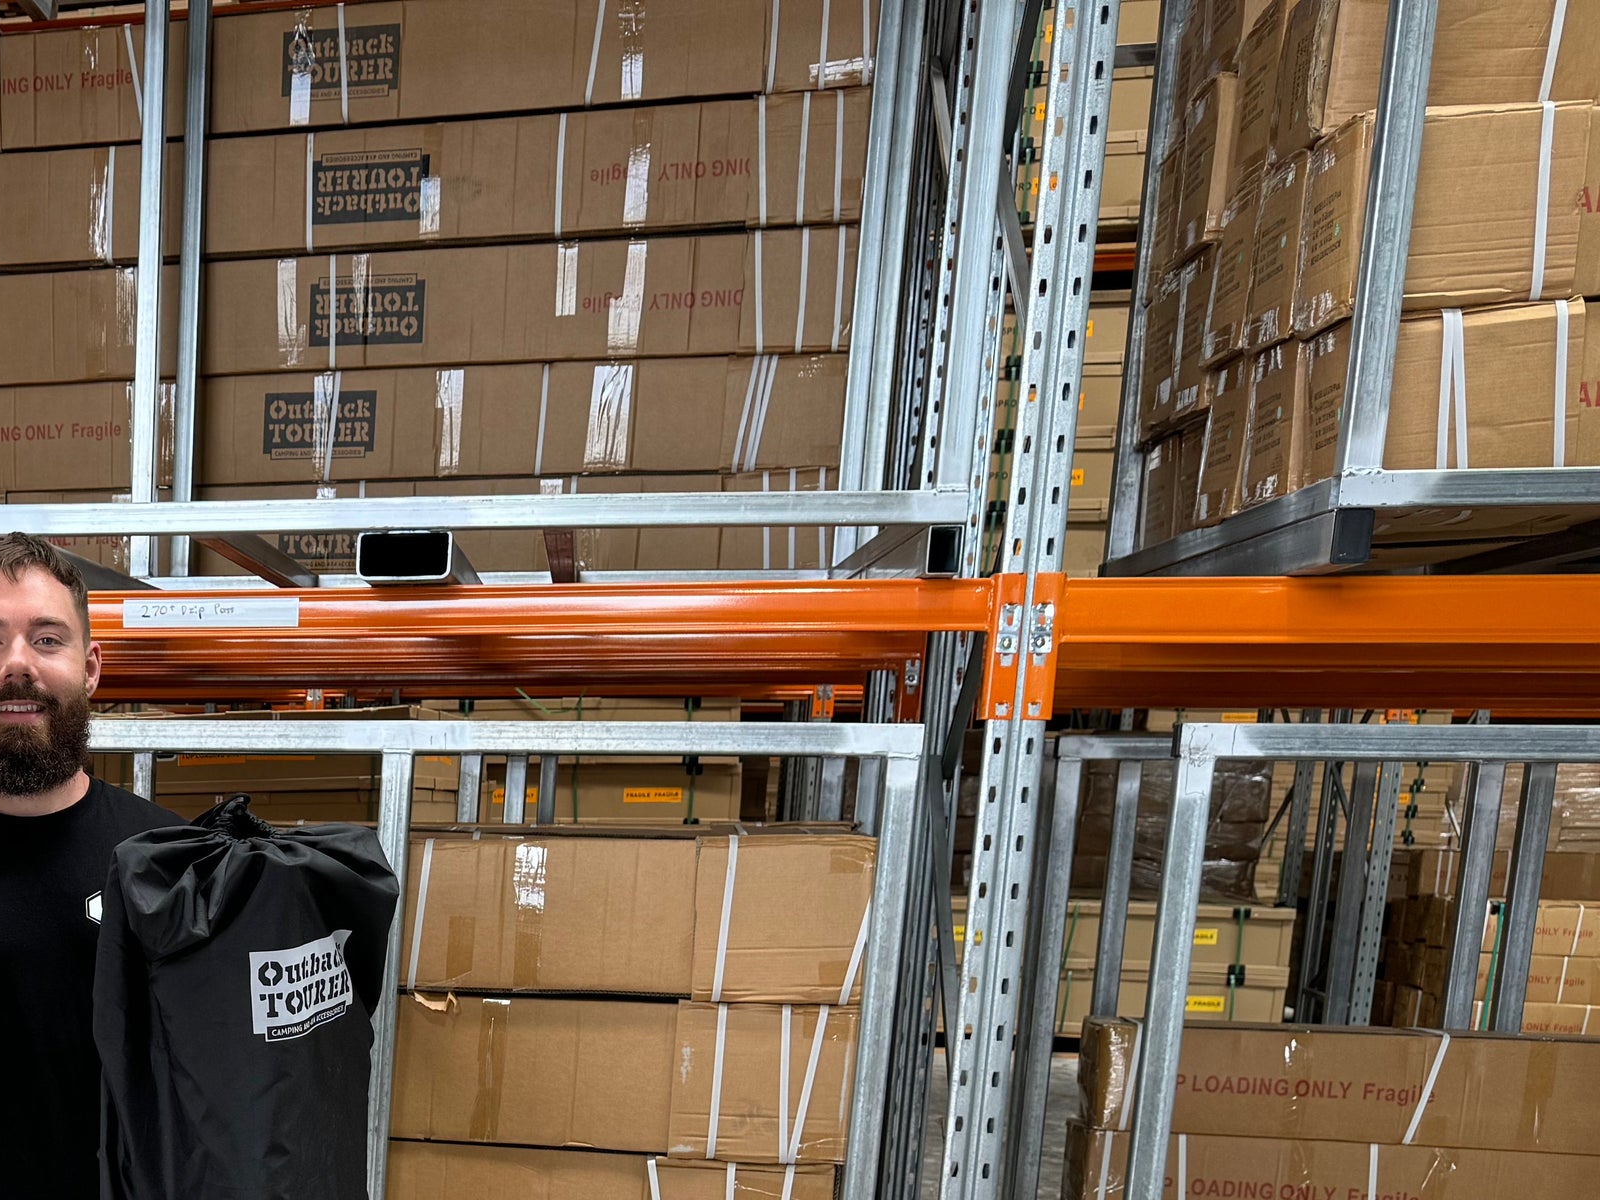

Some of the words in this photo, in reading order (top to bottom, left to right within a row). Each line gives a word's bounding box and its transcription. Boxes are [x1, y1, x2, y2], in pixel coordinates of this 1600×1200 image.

[2, 77, 29, 95] ING
[33, 73, 74, 92] ONLY
[81, 69, 133, 90] Fragile
[657, 161, 707, 182] ONLY
[712, 158, 750, 177] ING
[317, 166, 420, 193] TOURER
[316, 192, 420, 216] Outback
[650, 292, 696, 311] ONLY
[25, 423, 65, 440] ONLY
[71, 421, 122, 441] Fragile
[259, 968, 350, 1018] TOURER
[271, 1023, 303, 1037] CAMPING
[1192, 1075, 1289, 1097] LOADING
[1295, 1079, 1353, 1099] ONLY
[1186, 1178, 1273, 1200] OADING
